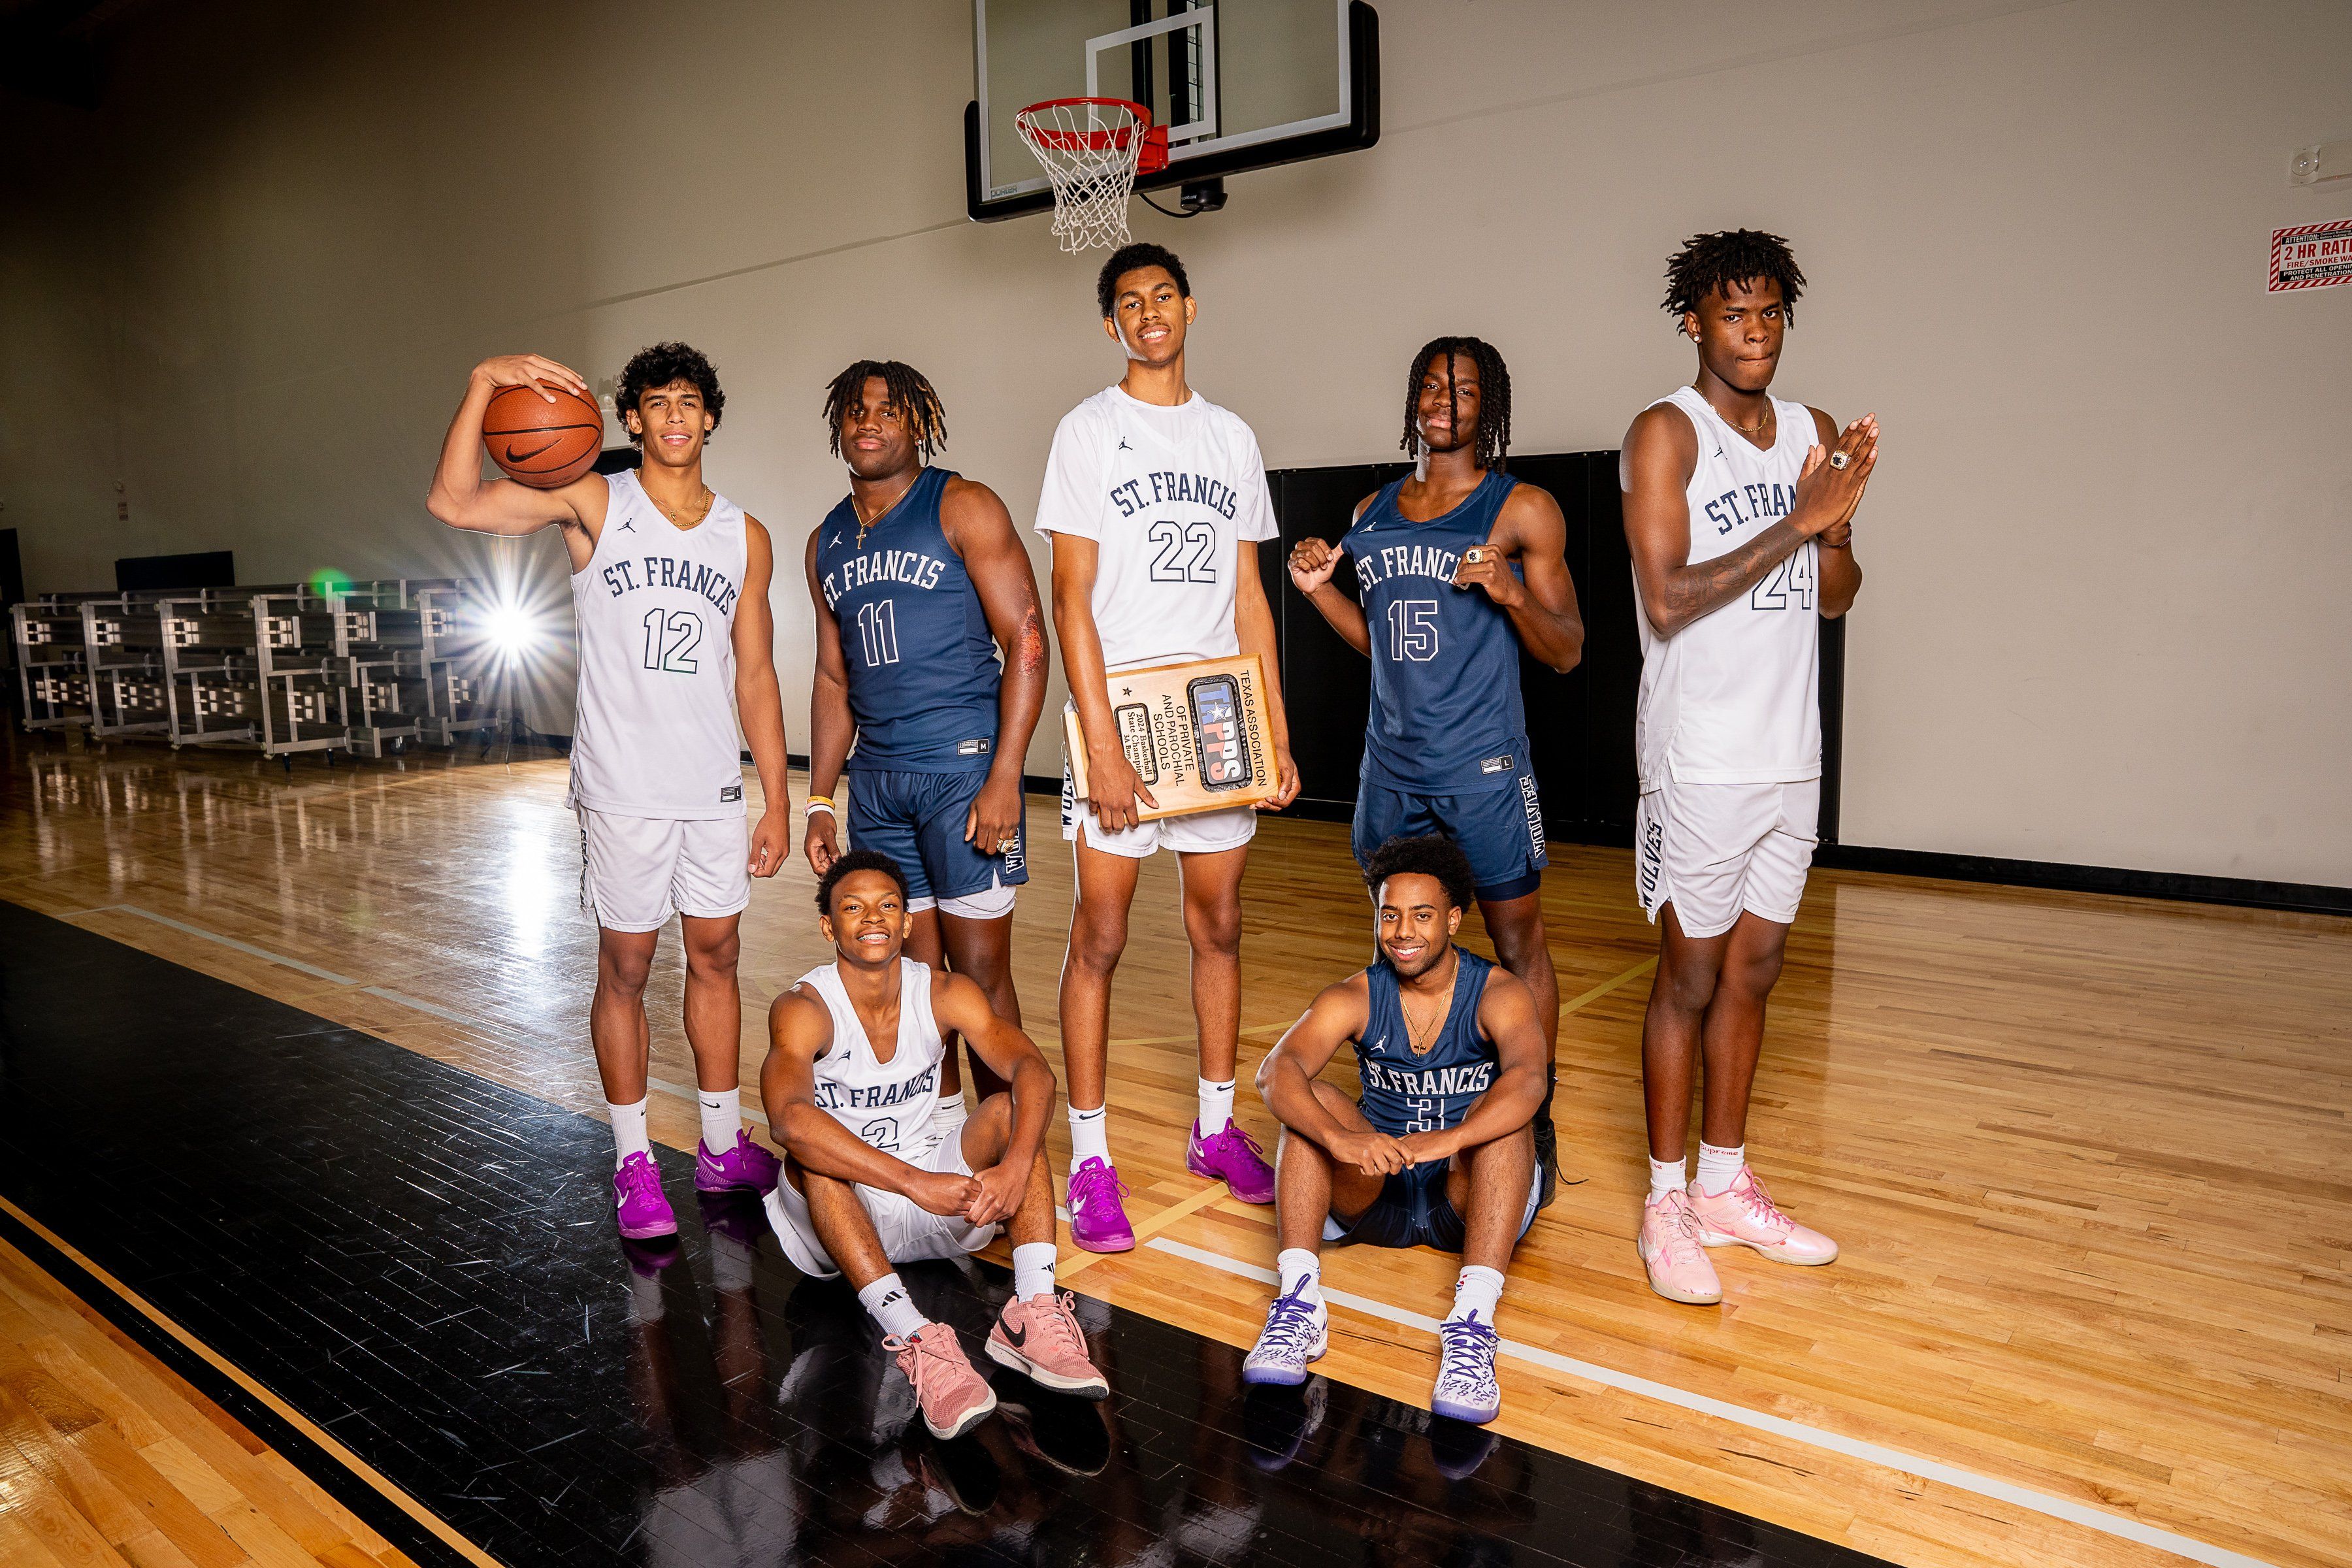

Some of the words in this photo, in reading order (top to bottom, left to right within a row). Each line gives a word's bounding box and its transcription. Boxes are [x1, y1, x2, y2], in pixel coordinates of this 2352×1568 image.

[2284, 246, 2293, 261] 2
[2297, 243, 2317, 259] HR
[2285, 234, 2319, 244] ATTENTION:
[2283, 268, 2313, 276] PROTECT
[2287, 256, 2338, 269] FIRE/SMOKE
[1111, 479, 1150, 518] ST.
[1149, 472, 1237, 521] FRANCIS
[1705, 490, 1749, 535] ST.
[1149, 521, 1217, 584] 22
[1355, 555, 1382, 592] ST.
[603, 560, 640, 597] ST.
[644, 557, 738, 616] FRANCIS
[823, 572, 842, 611] ST.
[843, 550, 945, 591] FRANCIS
[1752, 541, 1812, 610] 24
[644, 608, 703, 674] 12
[857, 599, 900, 667] 11
[1388, 600, 1439, 661] 15
[1162, 694, 1174, 718] AND
[1240, 670, 1254, 707] TEXAS
[1127, 711, 1135, 733] State
[1136, 713, 1145, 732] 2024
[1176, 706, 1187, 721] OF
[1198, 685, 1241, 781] TAPPS
[1124, 734, 1130, 743] 3A
[1139, 735, 1152, 776] Basketball
[1153, 713, 1171, 770] SCHOOLS
[1166, 721, 1184, 786] PAROCHIAL
[1179, 724, 1194, 771] PRIVATE
[1246, 709, 1267, 787] ASSOCIATION
[849, 1063, 938, 1108] FRANCIS
[1365, 1058, 1391, 1090] ST.
[1388, 1062, 1494, 1095] FRANCIS
[1700, 1143, 1739, 1155] Supreme
